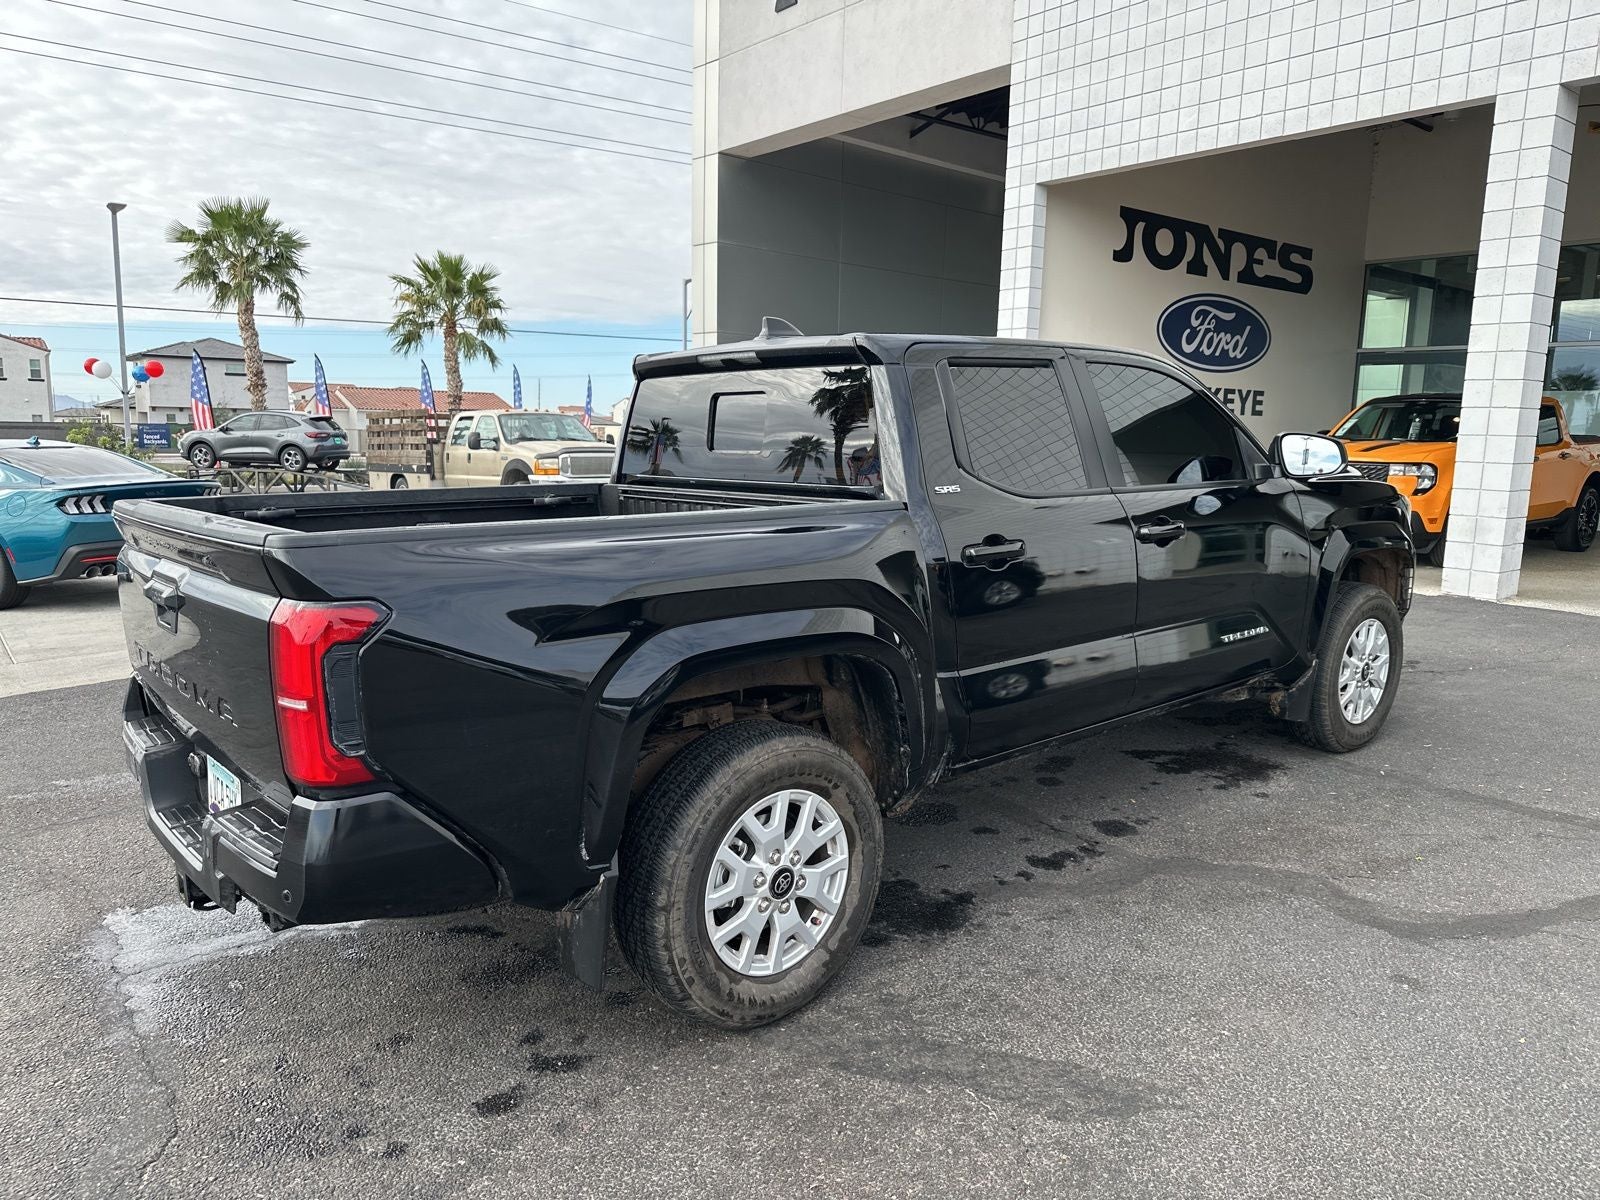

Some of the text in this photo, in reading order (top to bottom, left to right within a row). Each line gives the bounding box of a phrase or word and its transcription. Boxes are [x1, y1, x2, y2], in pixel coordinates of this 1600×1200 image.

[1113, 205, 1314, 295] JONES
[1181, 305, 1251, 359] Ford
[934, 484, 961, 494] SR5
